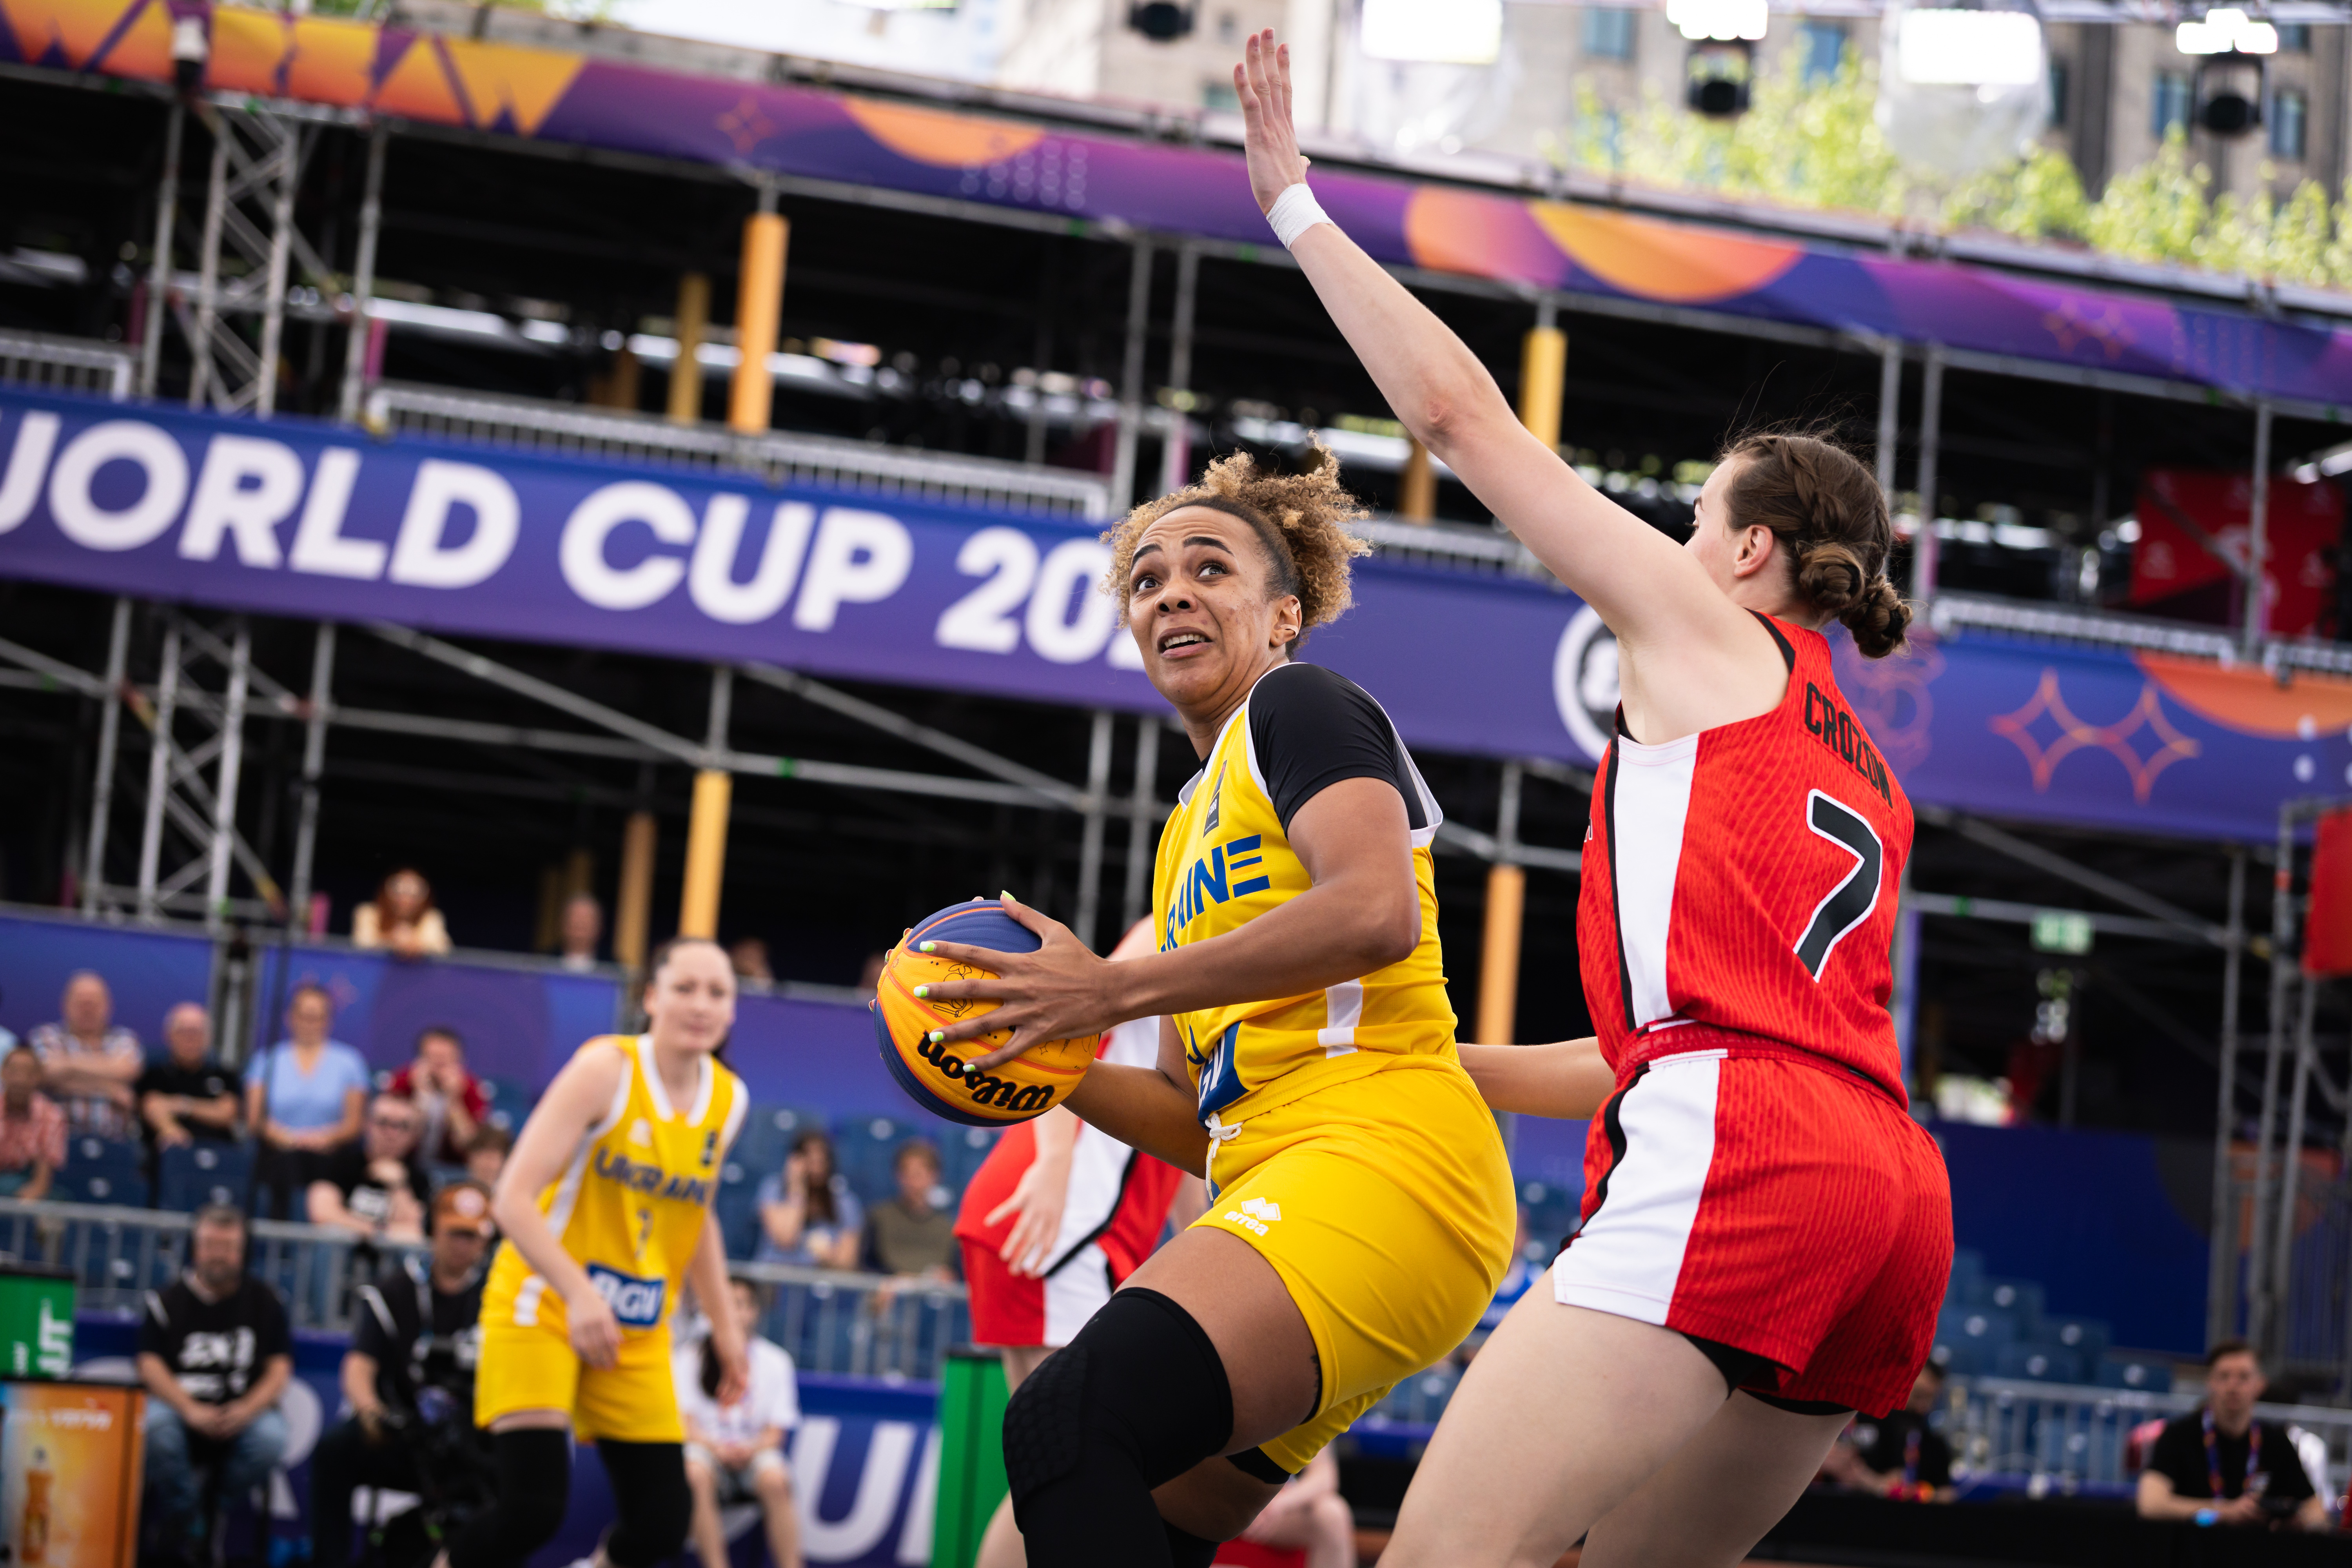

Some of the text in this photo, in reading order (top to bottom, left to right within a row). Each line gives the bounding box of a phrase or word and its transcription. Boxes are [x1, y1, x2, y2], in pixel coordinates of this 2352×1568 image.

[558, 478, 916, 633] CUP
[1805, 681, 1893, 809] CROZON
[1160, 833, 1271, 953] RAINE
[1792, 788, 1883, 984] 7
[917, 1029, 1056, 1111] Wilson
[1224, 1210, 1269, 1236] errea
